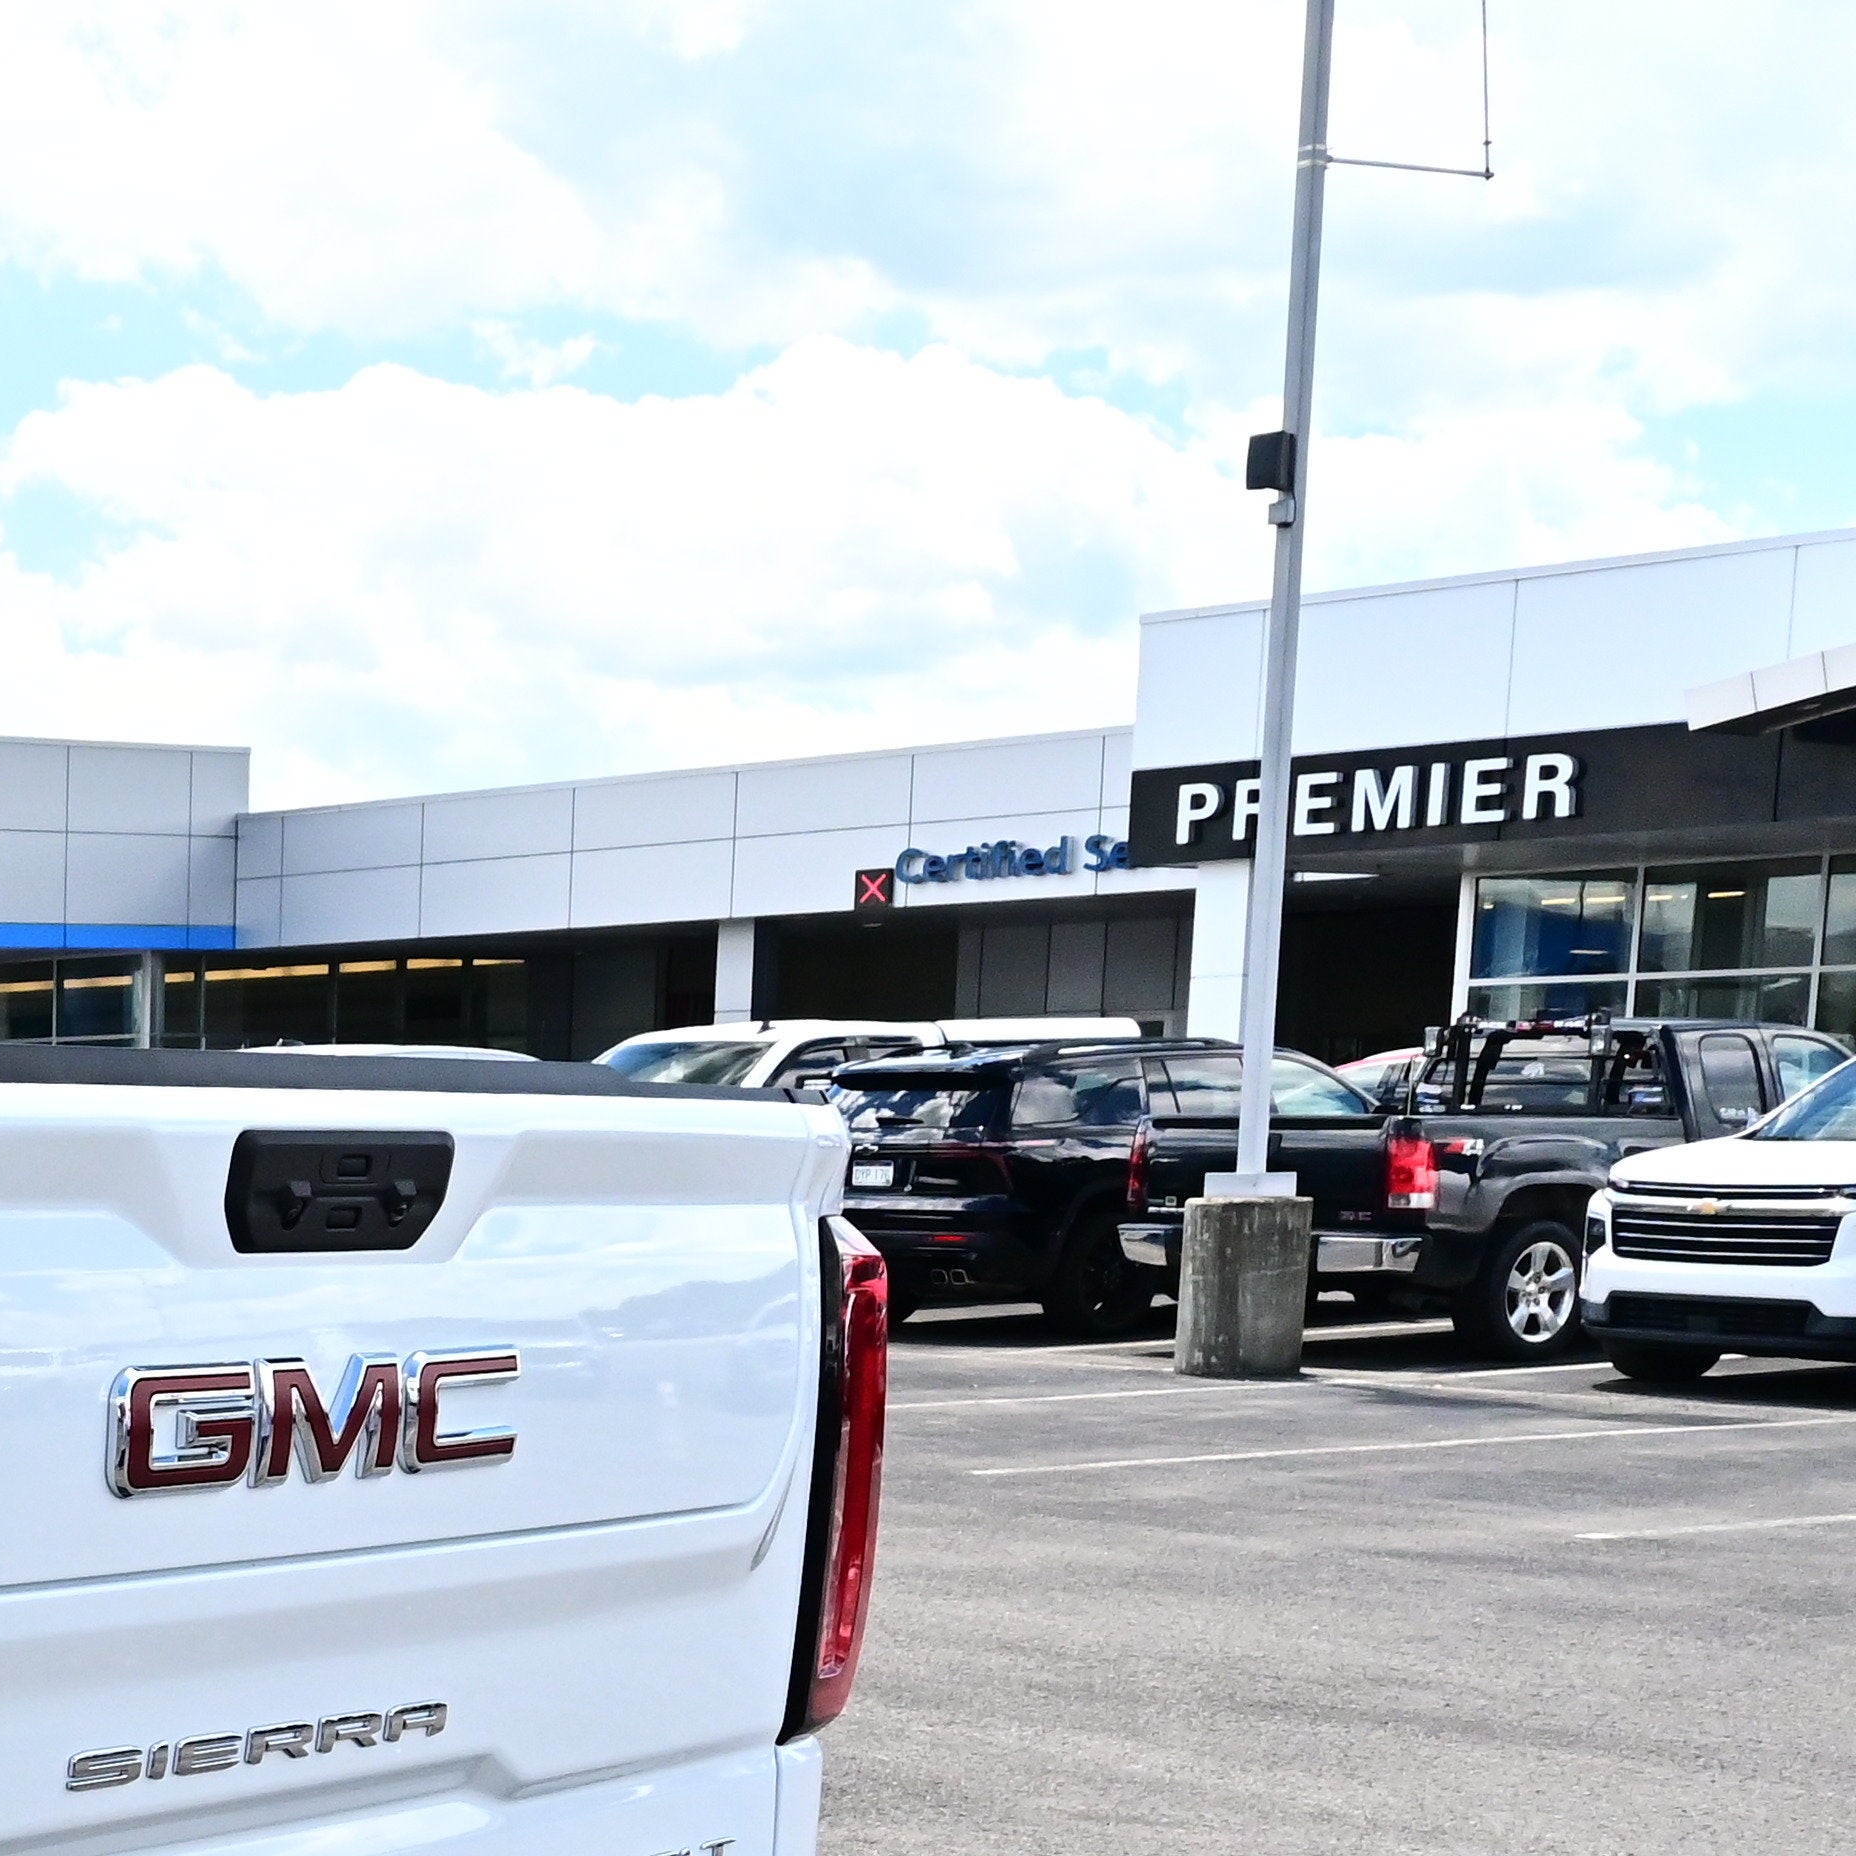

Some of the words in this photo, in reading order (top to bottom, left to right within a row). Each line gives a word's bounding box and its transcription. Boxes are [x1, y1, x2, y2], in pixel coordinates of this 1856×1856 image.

[1175, 753, 1578, 845] PREMIER
[895, 835, 1072, 884] Certified
[105, 1344, 521, 1498] GMC
[64, 1698, 449, 1792] SIERRA
